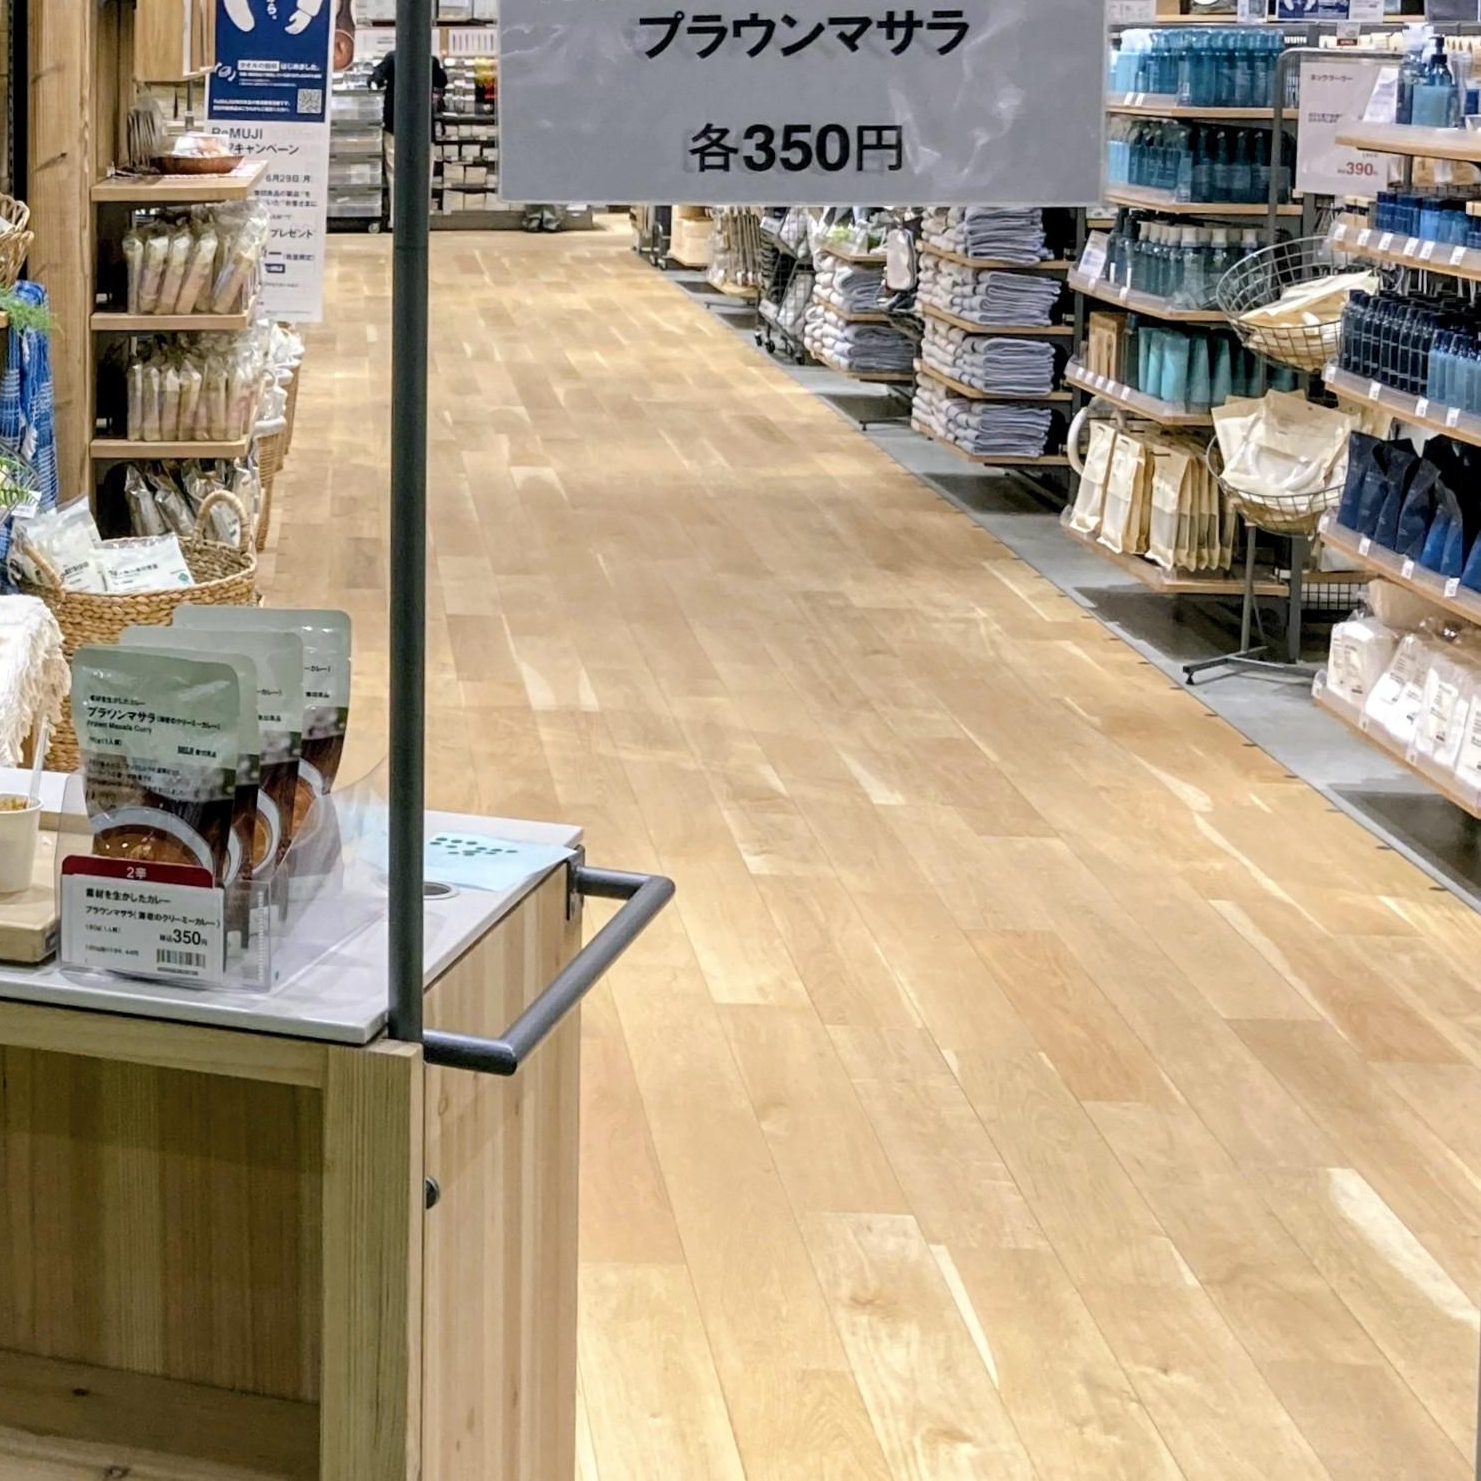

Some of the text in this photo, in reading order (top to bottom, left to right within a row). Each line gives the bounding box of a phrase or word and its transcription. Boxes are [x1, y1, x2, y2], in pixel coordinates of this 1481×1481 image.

[639, 10, 969, 60] プラウンマサラ
[229, 142, 299, 155] キャンペーン
[689, 123, 904, 174] 各350円
